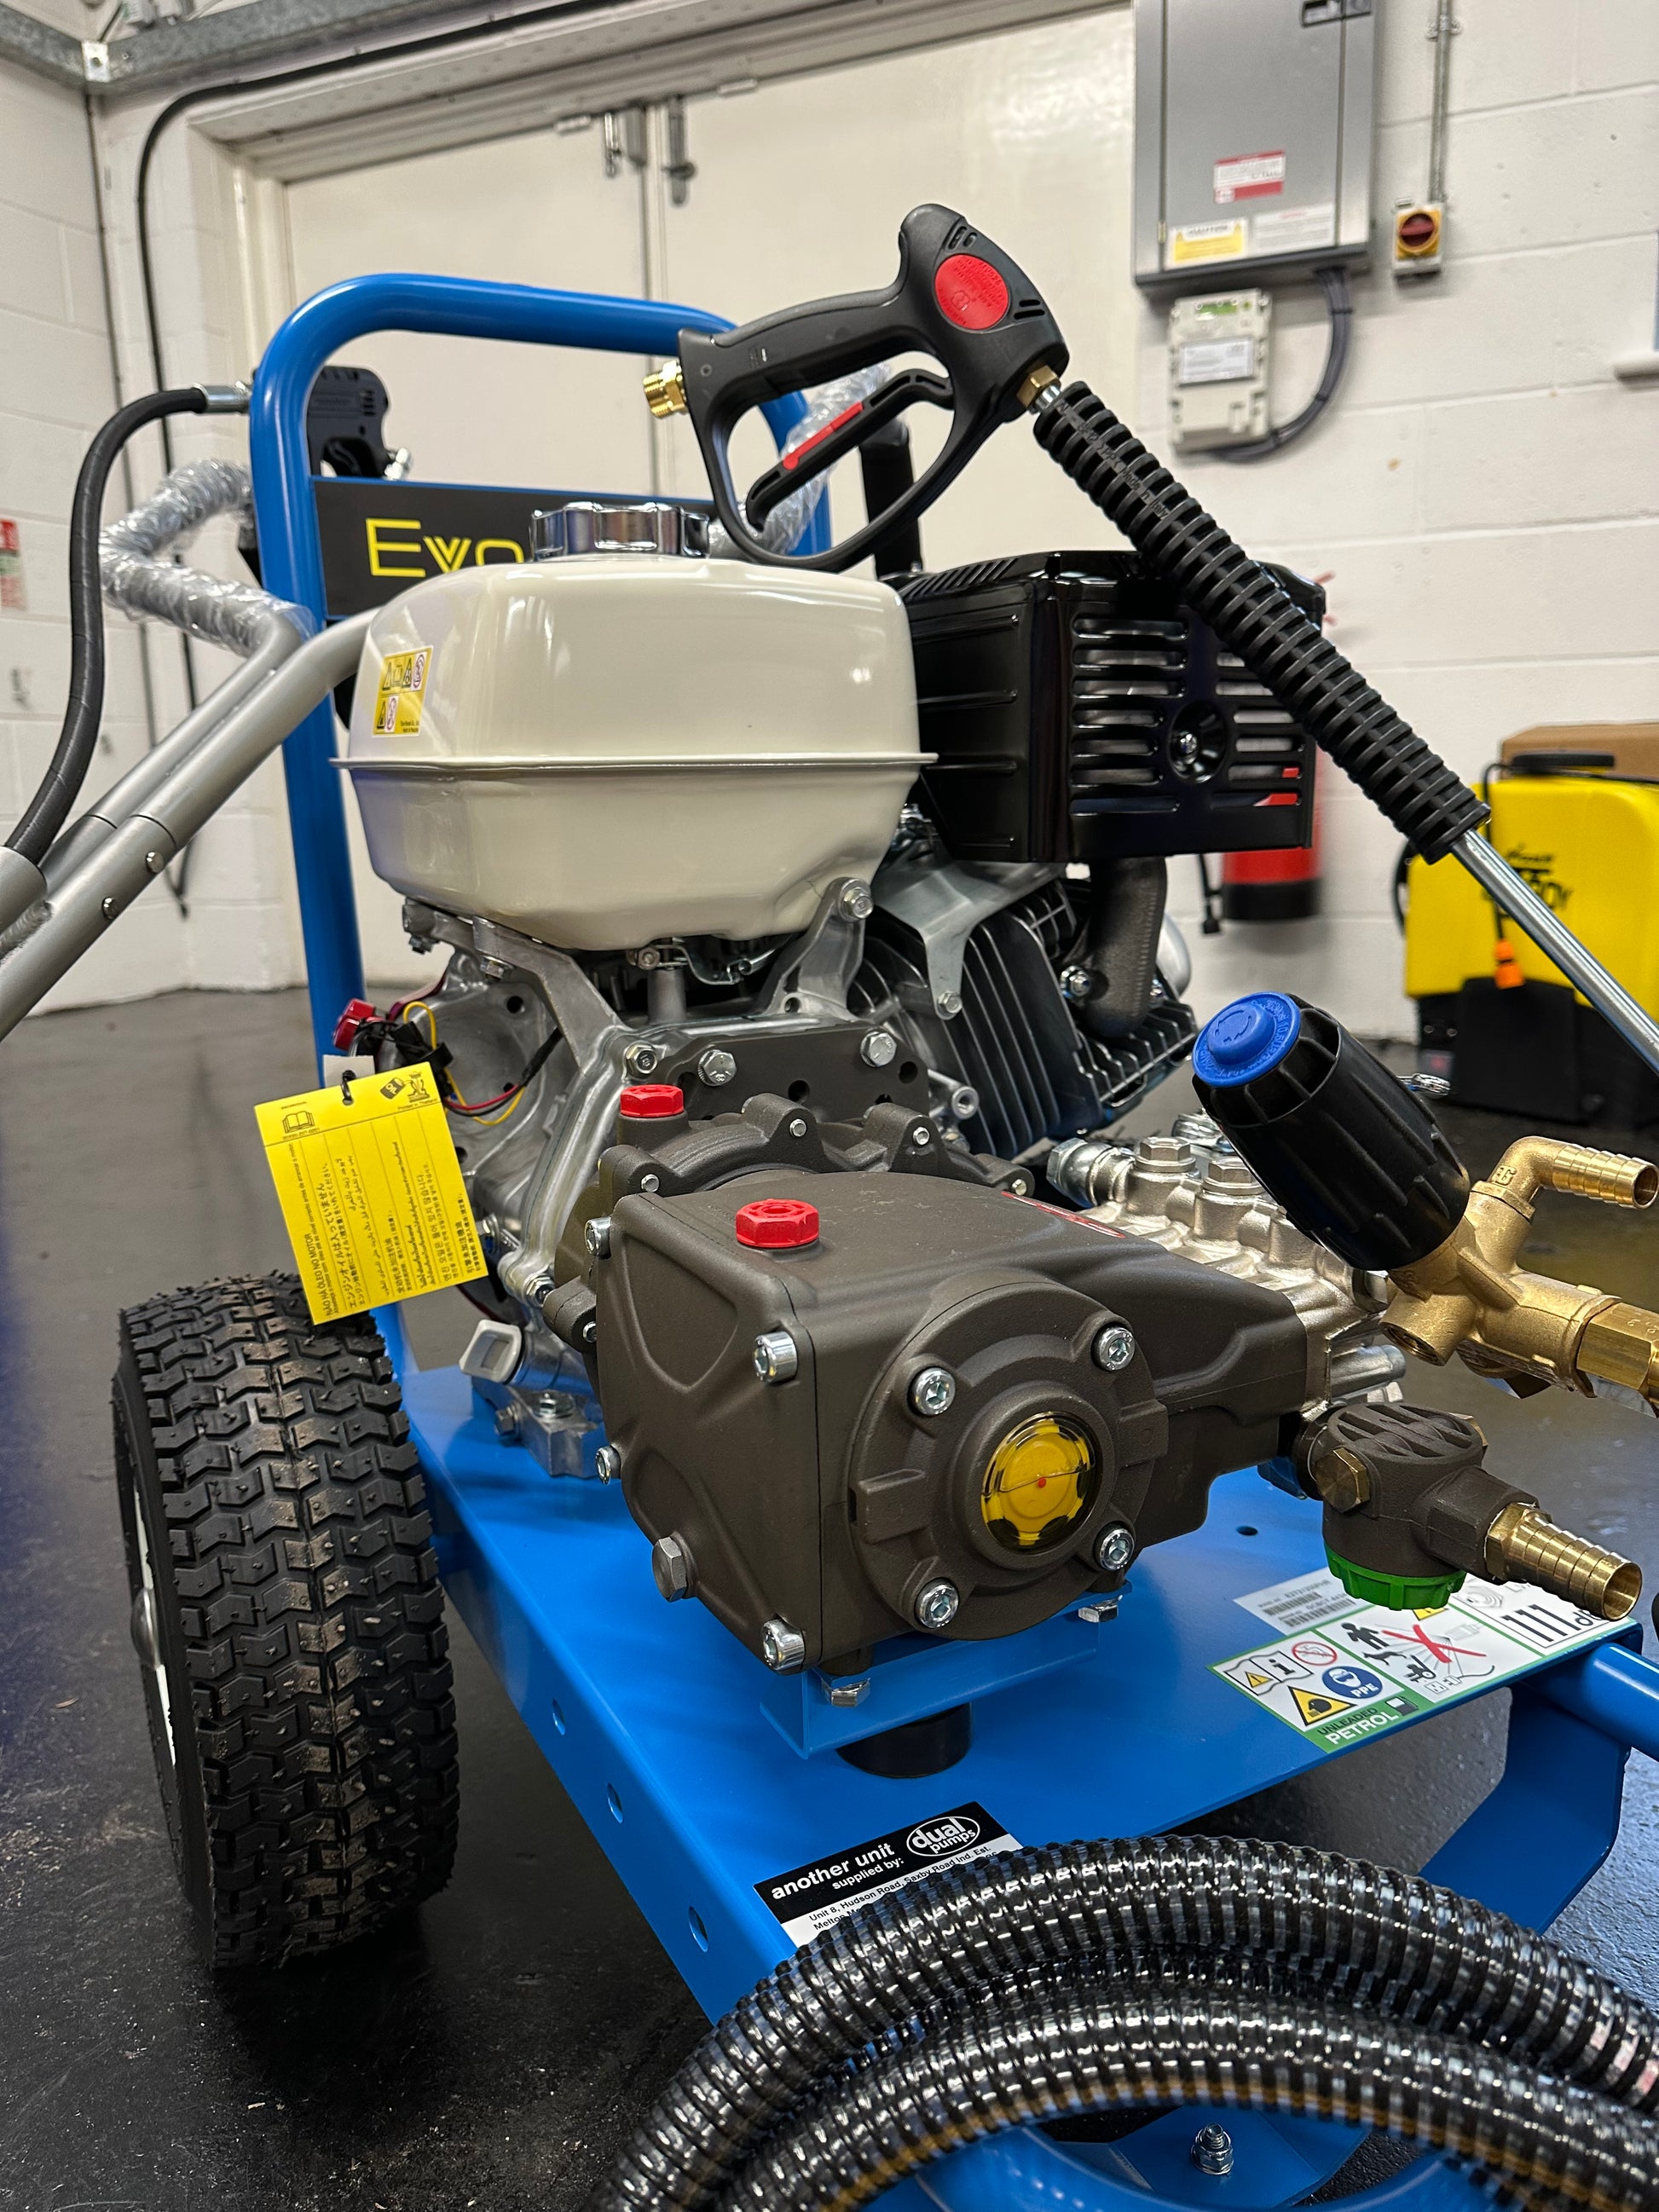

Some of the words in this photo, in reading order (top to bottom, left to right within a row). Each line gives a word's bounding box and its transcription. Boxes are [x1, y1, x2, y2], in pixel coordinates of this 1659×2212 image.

[303, 1232, 318, 1258] MOTOR
[309, 1257, 321, 1270] NO
[1350, 1683, 1379, 1697] PPE
[1317, 1707, 1379, 1735] UNLEADED
[1325, 1712, 1399, 1744] PETROL
[911, 1817, 966, 1849] dual
[929, 1828, 976, 1854] pumps
[771, 1854, 849, 1900] another
[855, 1842, 895, 1867] unit
[809, 1907, 830, 1921] Unit
[841, 1890, 877, 1909] Hudson
[876, 1880, 905, 1901] Road,
[904, 1869, 933, 1885] Saxby
[932, 1859, 957, 1874] Road
[956, 1851, 974, 1864] Ind.
[974, 1845, 991, 1856] Est.
[832, 1864, 883, 1890] supplied
[886, 1857, 904, 1872] by:
